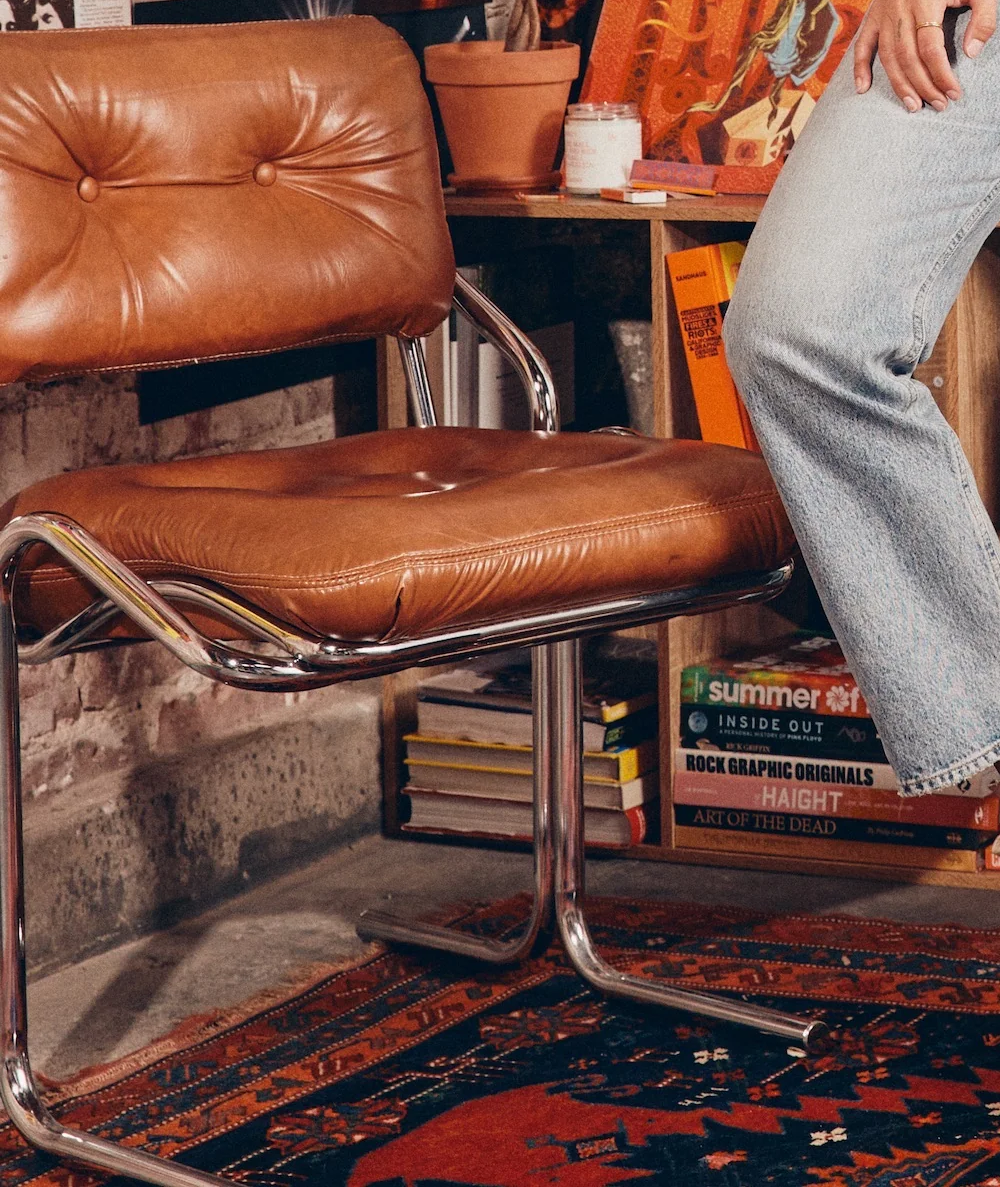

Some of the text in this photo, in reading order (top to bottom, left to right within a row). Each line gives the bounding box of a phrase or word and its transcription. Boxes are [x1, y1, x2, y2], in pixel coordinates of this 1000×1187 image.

[709, 679, 821, 710] summer
[718, 714, 824, 734] INSIDE OUT
[787, 733, 801, 741] PINK
[803, 734, 823, 743] FLOYD
[685, 754, 874, 787] ROCK GRAPHIC ORIGINALS
[761, 785, 843, 813] HAIGHT
[693, 809, 837, 835] ART OF THE DEAD
